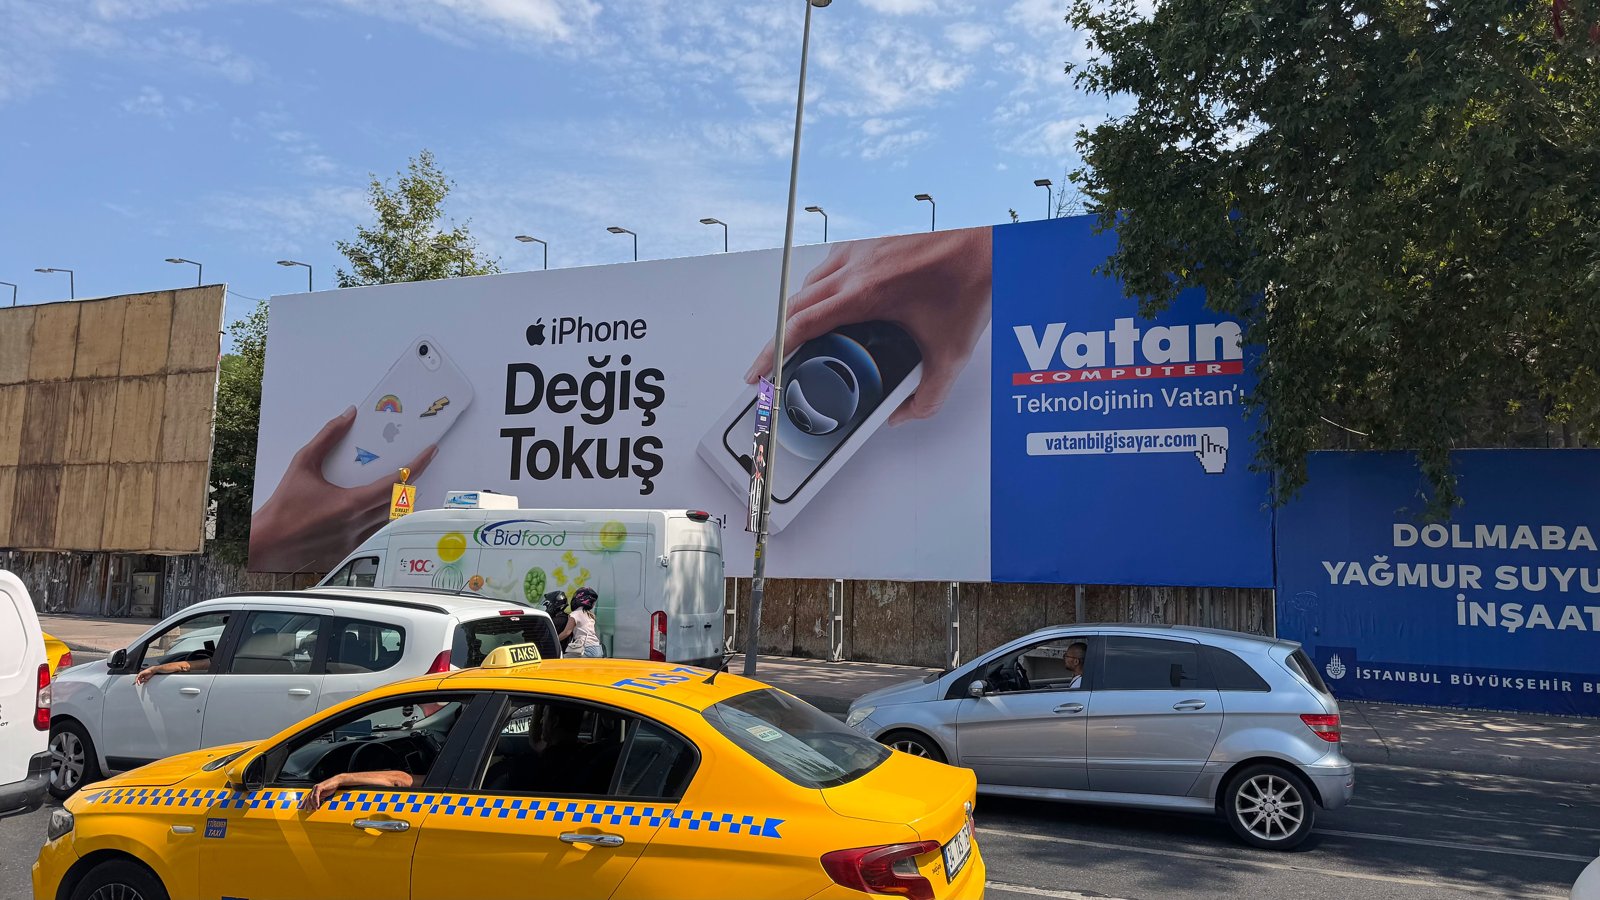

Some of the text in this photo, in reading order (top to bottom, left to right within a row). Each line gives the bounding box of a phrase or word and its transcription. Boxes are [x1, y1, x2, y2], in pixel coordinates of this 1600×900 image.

[551, 316, 647, 345] iPhone
[1012, 317, 1243, 371] Vatan
[1030, 364, 1223, 383] COMPUTER
[505, 354, 666, 427] Değiş
[1012, 390, 1154, 415] Teknolojinin
[1045, 432, 1197, 453] vatanbilgisayar.com
[500, 426, 664, 495] Tokuş
[493, 529, 567, 546] Bidfood
[1393, 523, 1598, 550] DOLMABA
[1321, 554, 1600, 594] YAĞMUR SUYU
[1456, 593, 1600, 633] İNŞAAT
[1356, 666, 1442, 684] İSTANBUL
[1451, 673, 1572, 692] BÜYÜKŞEHİR
